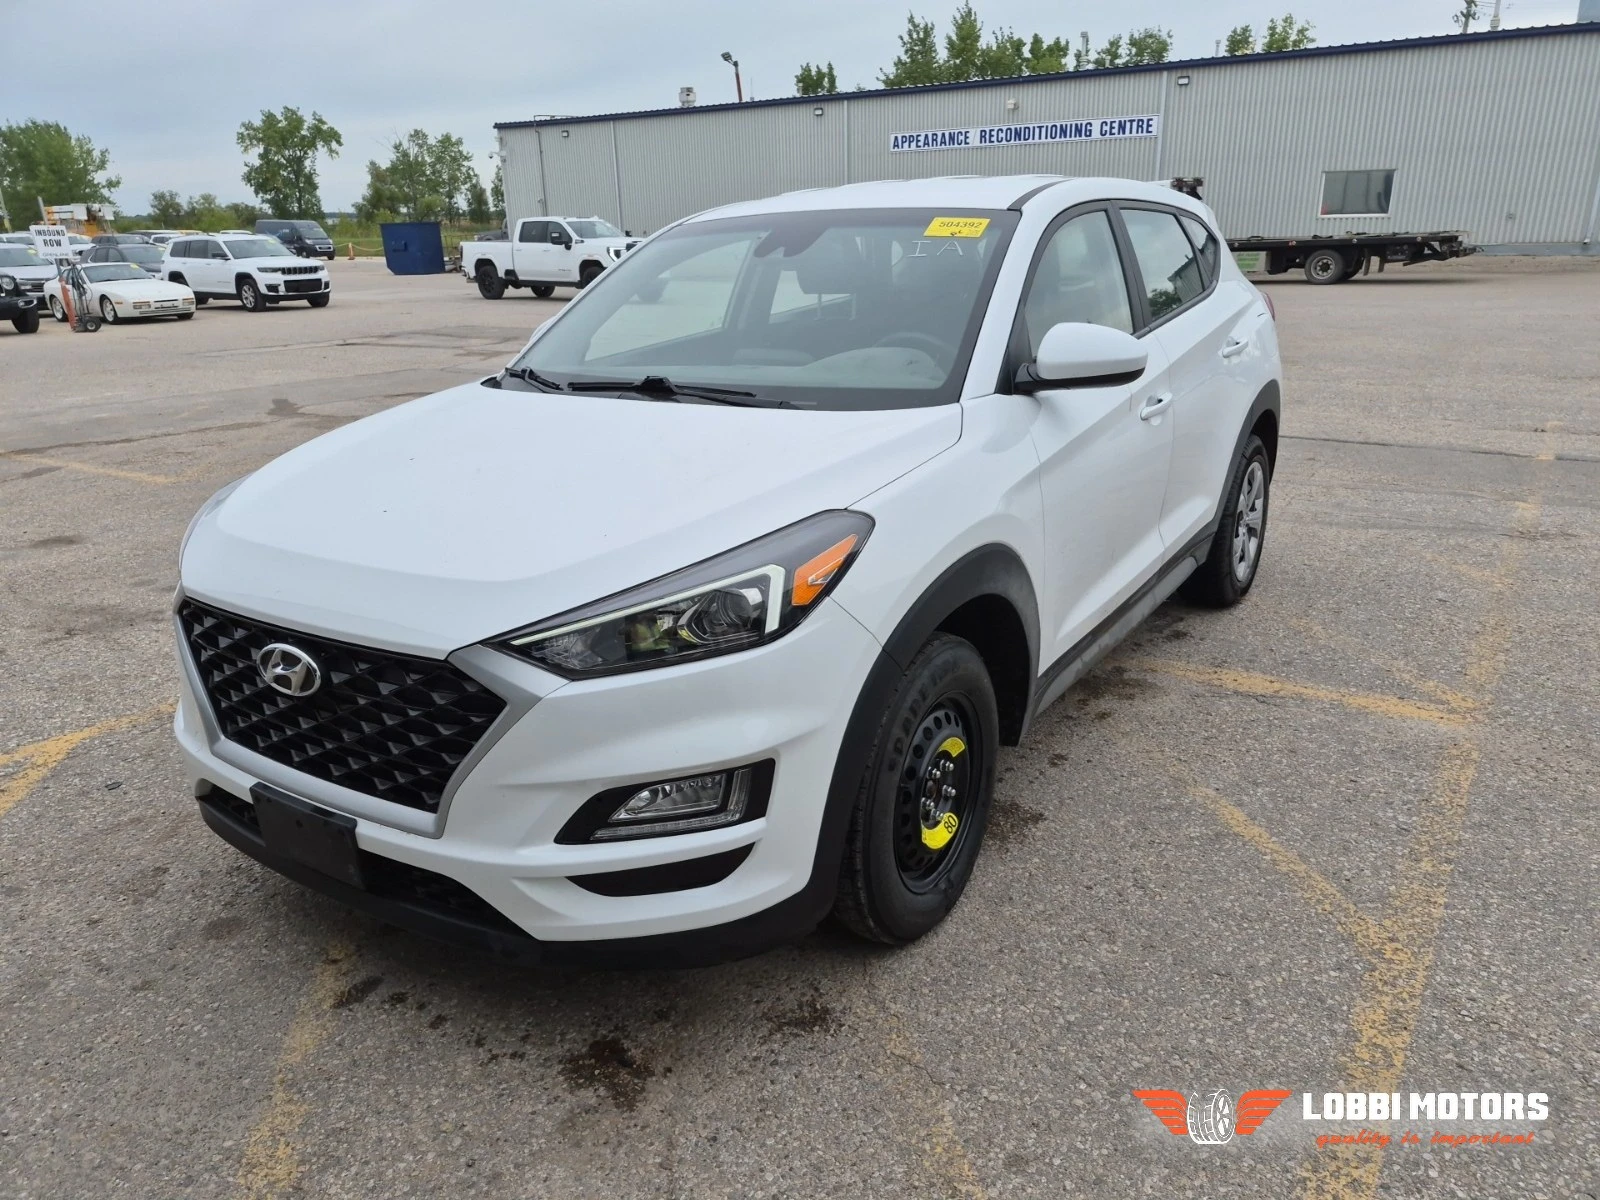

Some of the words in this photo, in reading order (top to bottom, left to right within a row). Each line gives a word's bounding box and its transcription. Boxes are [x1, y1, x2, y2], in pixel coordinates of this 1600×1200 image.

[892, 130, 970, 150] APPEARANCE
[979, 121, 1093, 145] RECONDITIONING
[1099, 118, 1154, 137] CENTRE
[42, 239, 62, 247] ROW
[943, 814, 957, 834] 80
